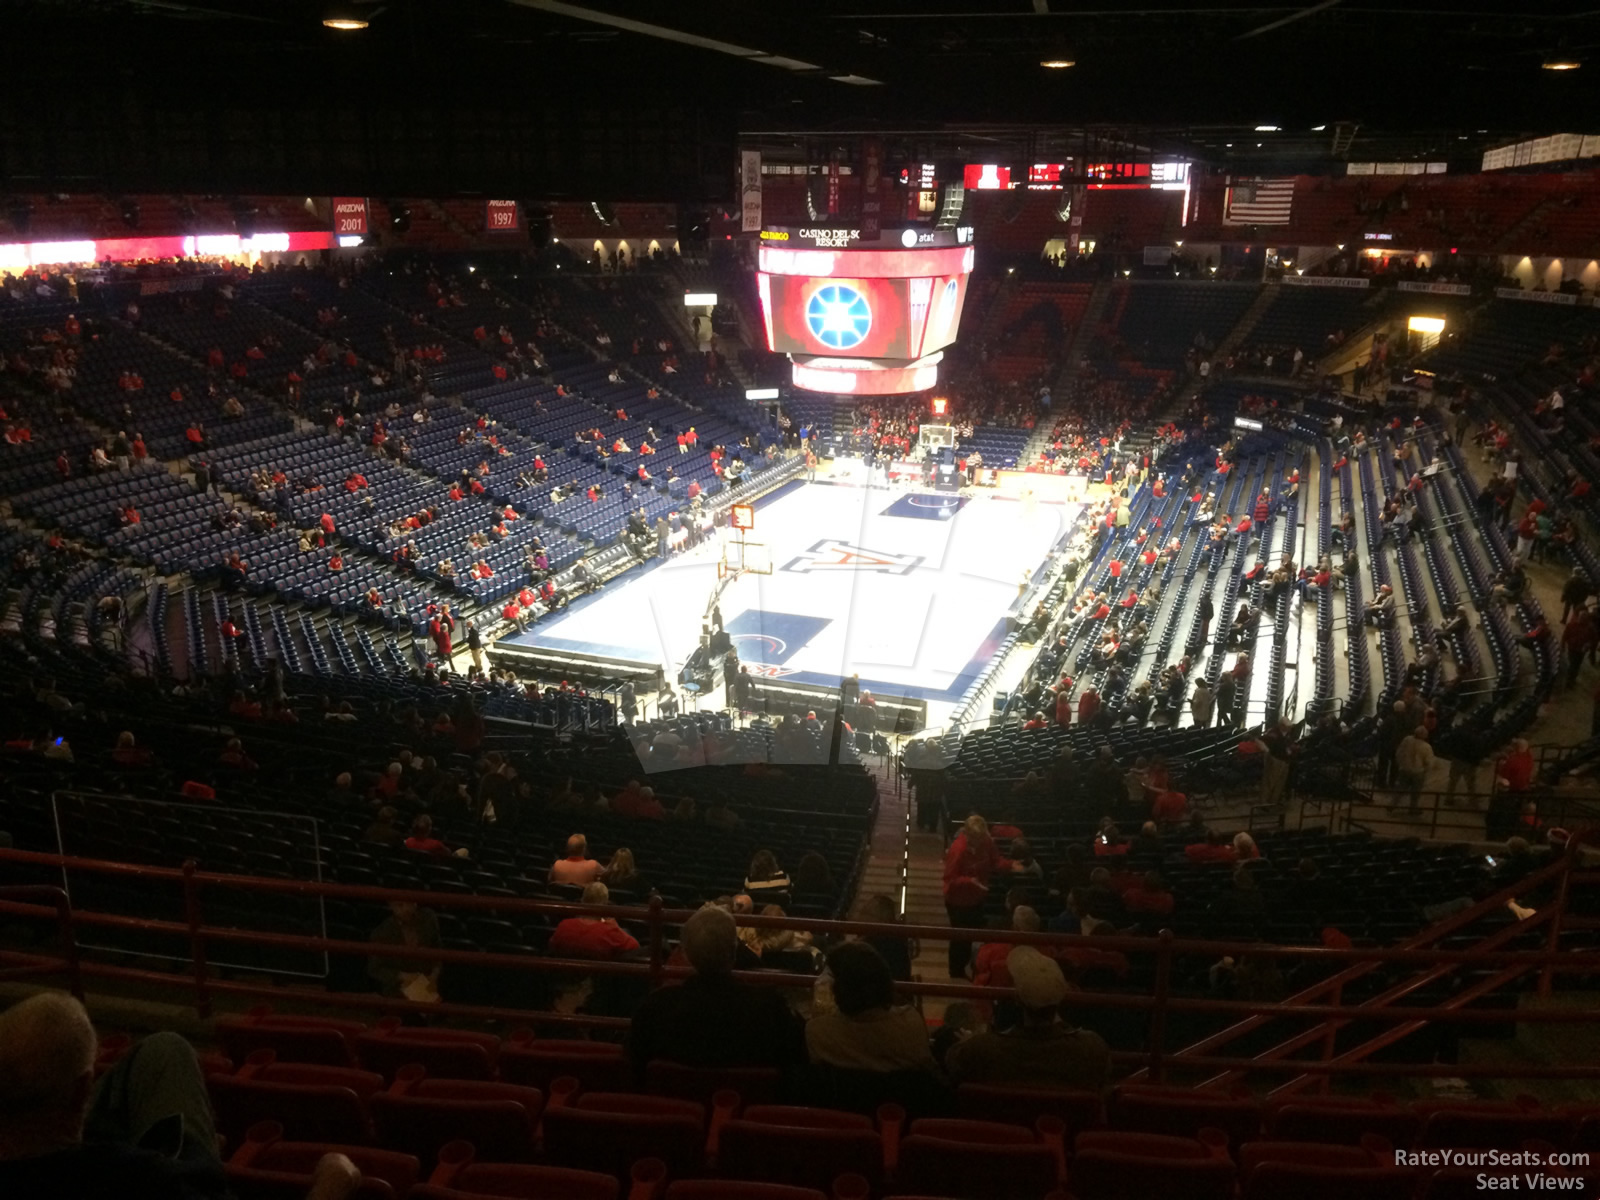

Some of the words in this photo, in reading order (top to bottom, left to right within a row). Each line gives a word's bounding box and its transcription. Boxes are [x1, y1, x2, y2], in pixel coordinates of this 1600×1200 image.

[336, 204, 365, 213] ARIZONA
[494, 212, 513, 225] 1997
[341, 218, 362, 231] 2001
[799, 229, 831, 238] CASINO
[832, 230, 850, 239] DEL
[816, 238, 850, 247] RESORT
